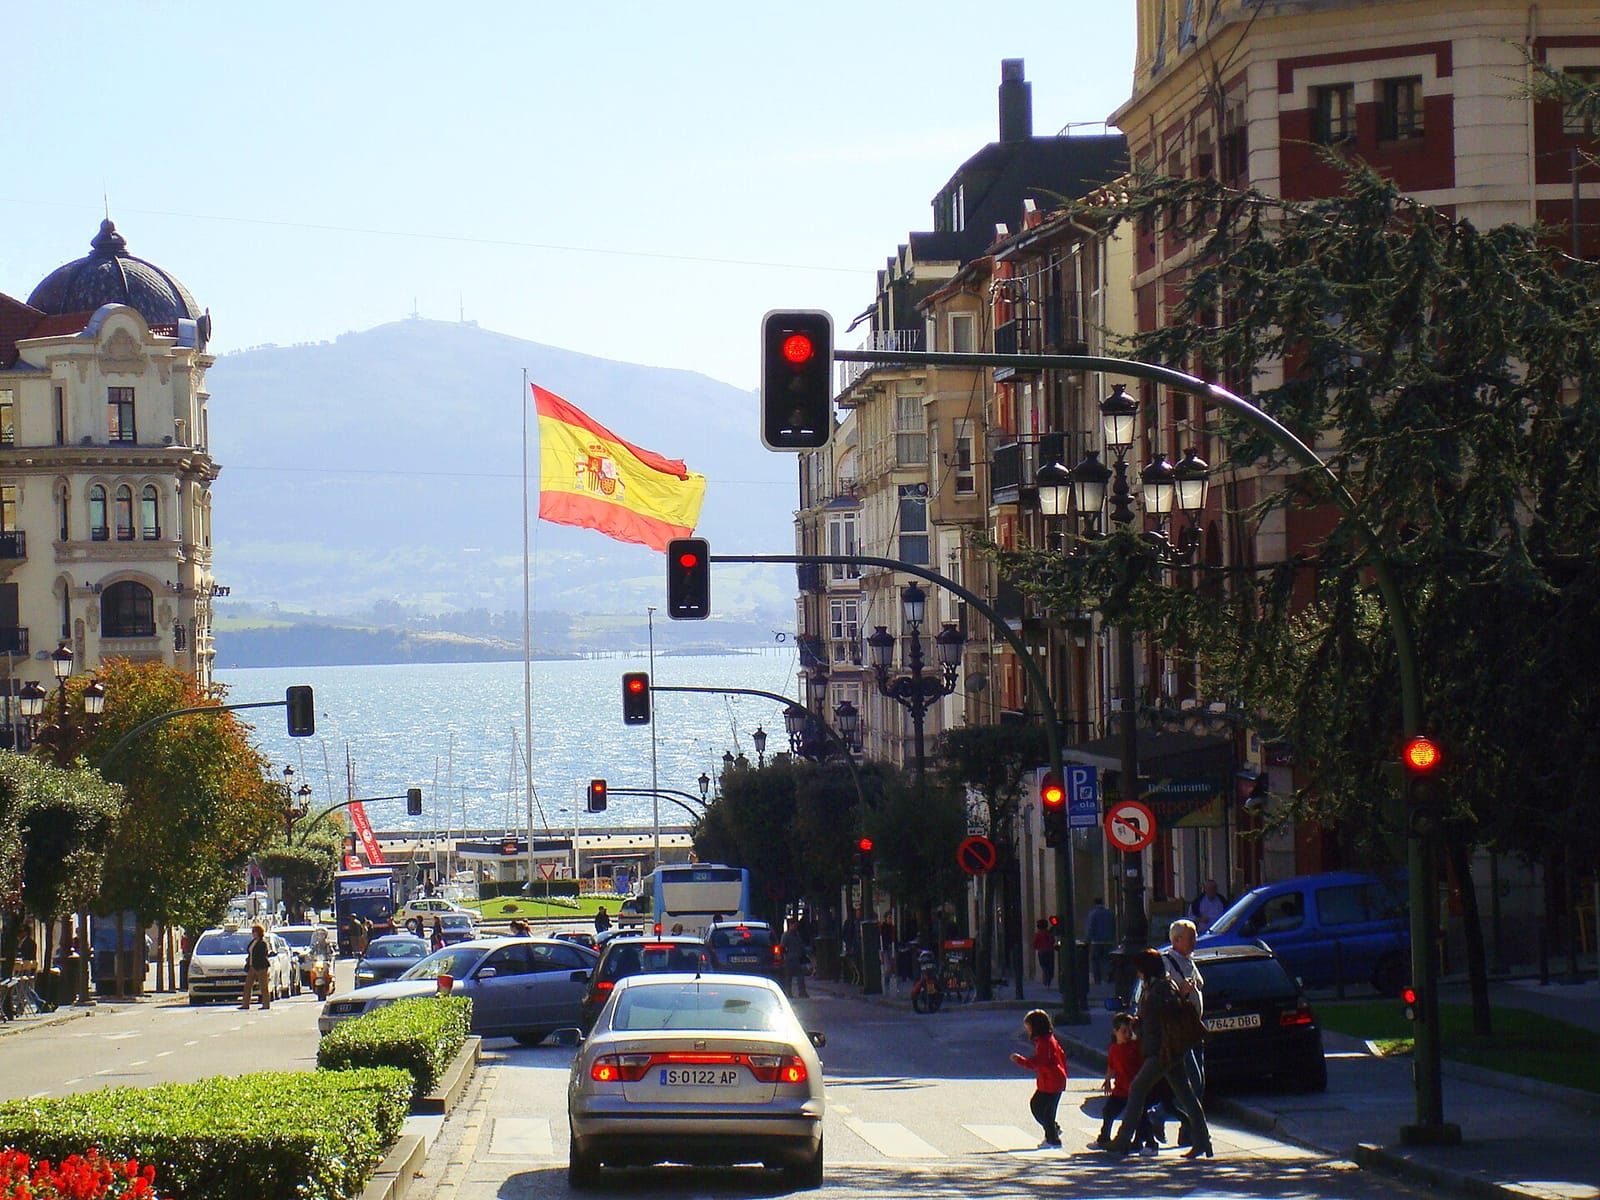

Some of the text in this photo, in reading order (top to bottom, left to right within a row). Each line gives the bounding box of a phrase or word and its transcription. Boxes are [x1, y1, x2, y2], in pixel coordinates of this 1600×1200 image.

[1073, 769, 1088, 801] P
[1147, 783, 1212, 793] Restaurante
[1209, 1015, 1259, 1031] 7642 DBG
[720, 1071, 737, 1084] AP
